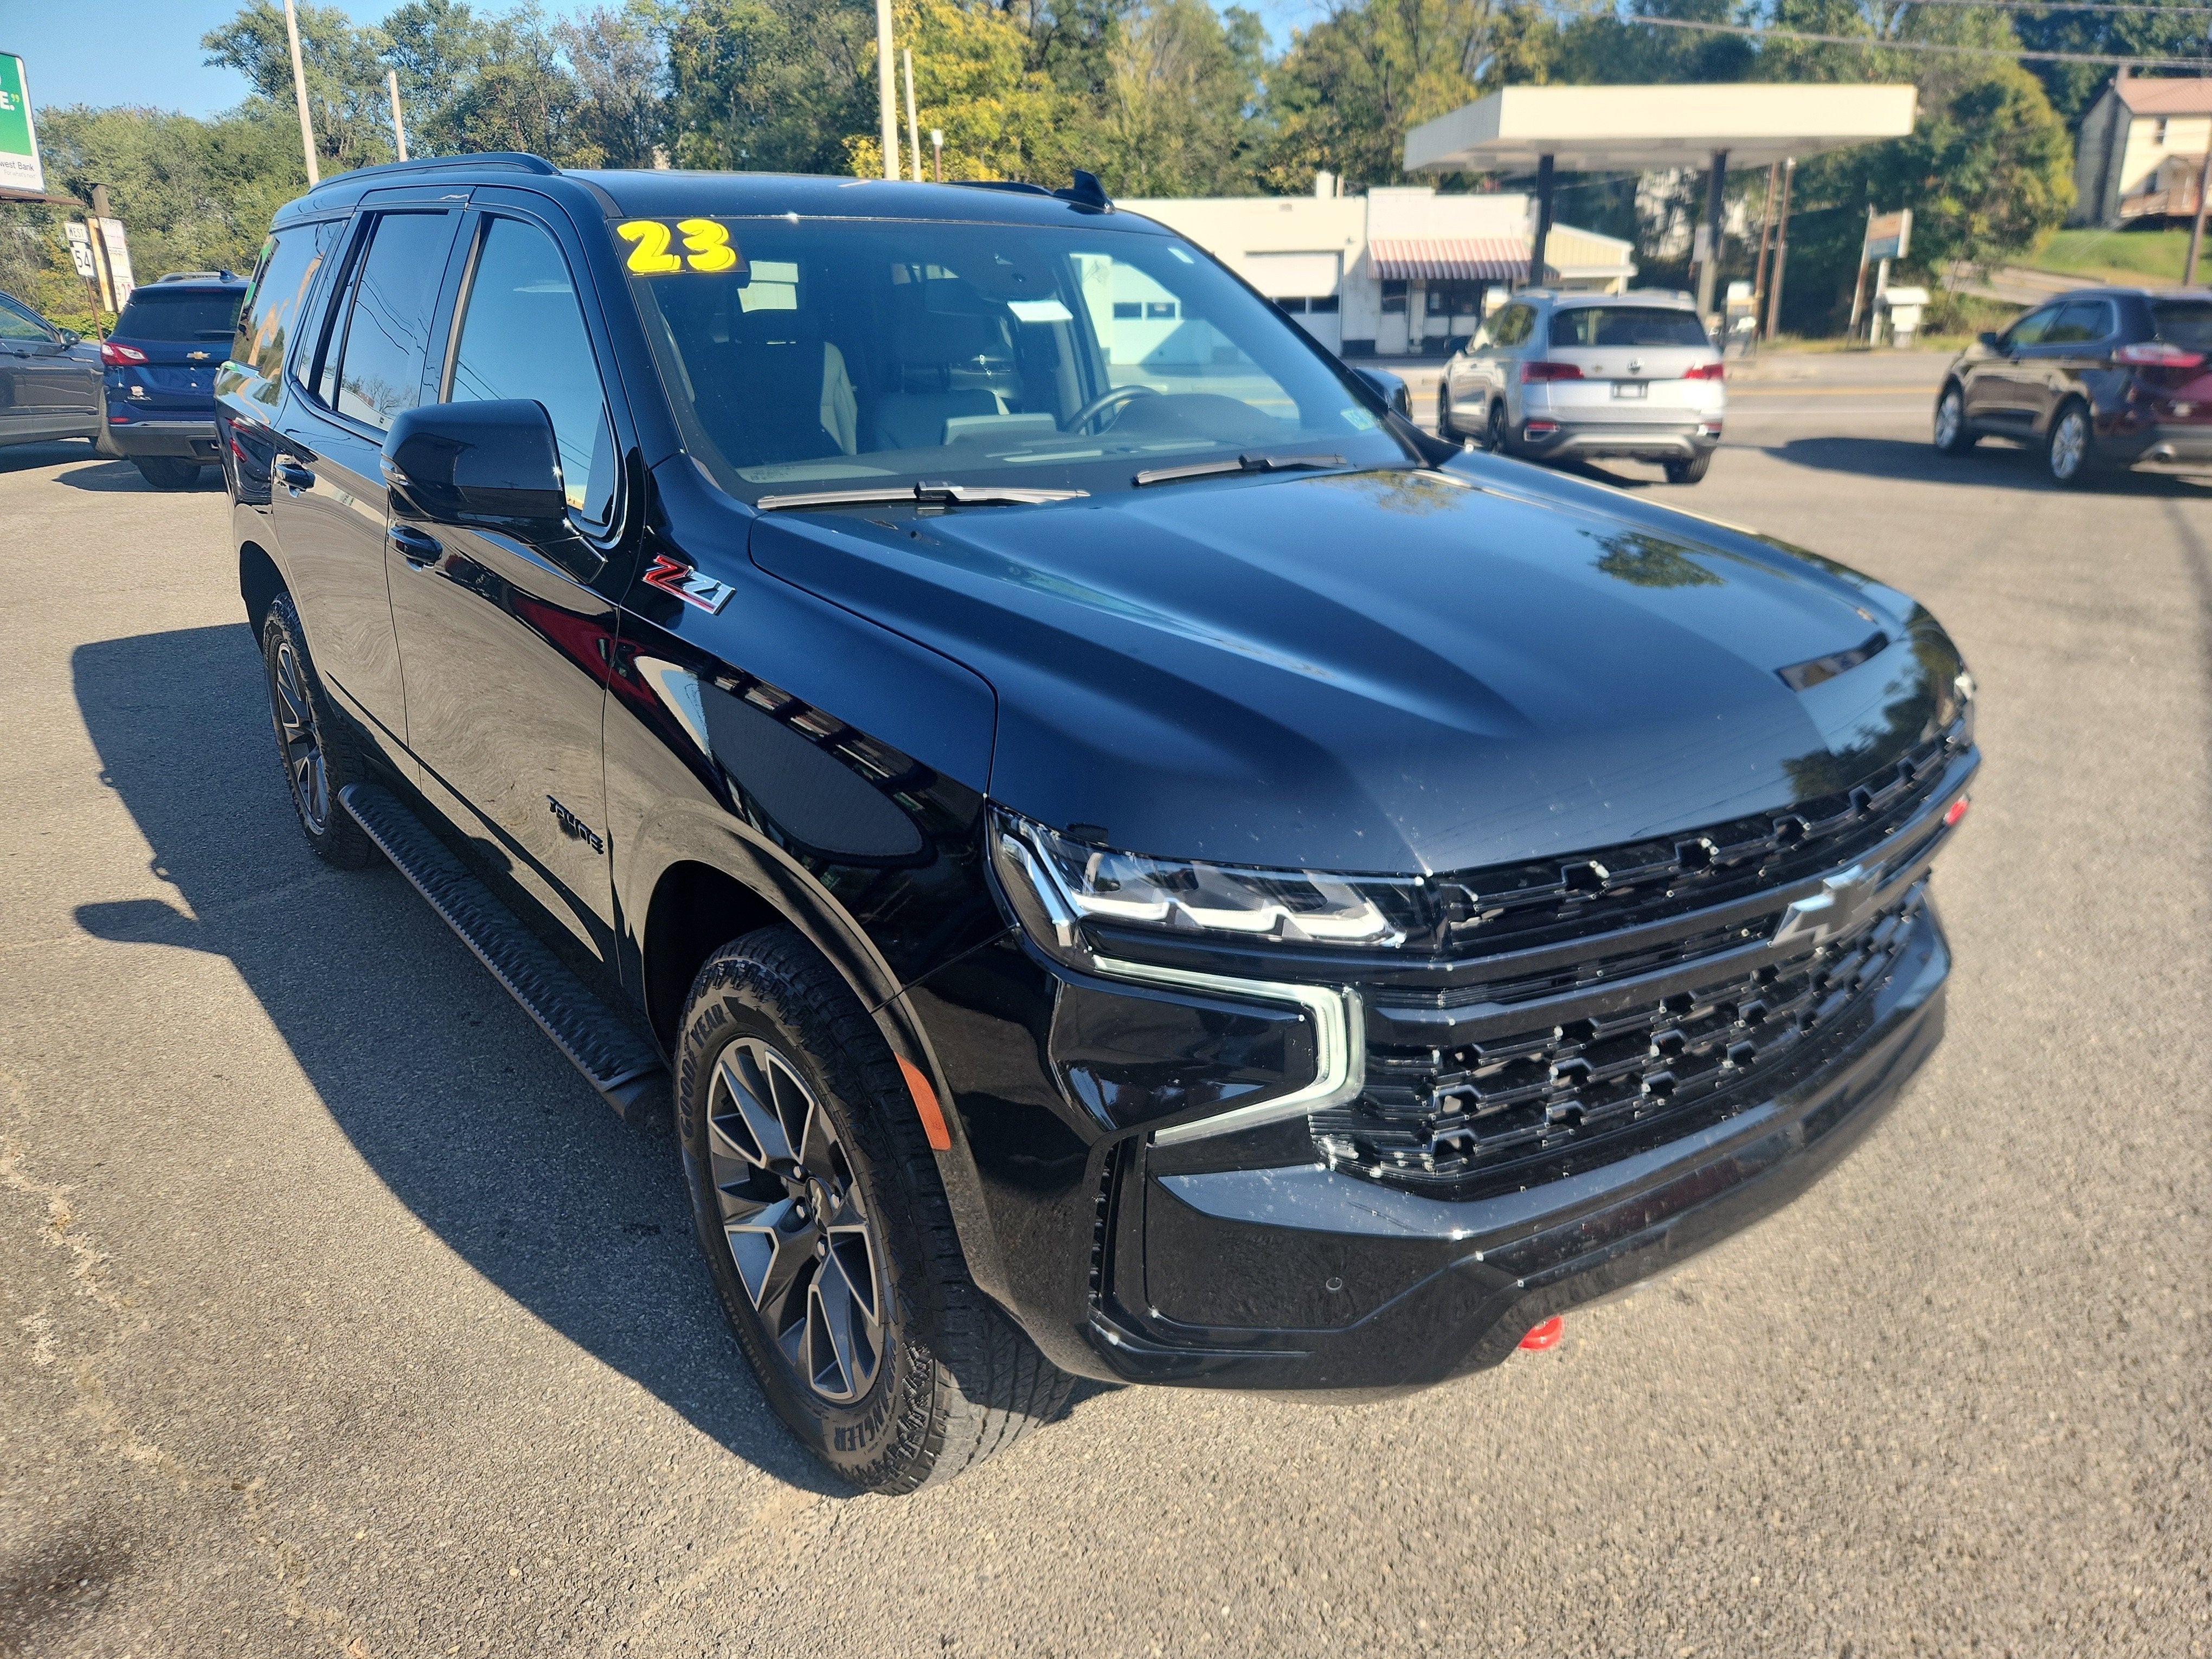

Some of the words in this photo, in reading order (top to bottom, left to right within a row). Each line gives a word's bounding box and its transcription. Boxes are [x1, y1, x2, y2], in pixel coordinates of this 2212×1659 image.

[17, 162, 34, 171] Bank
[67, 226, 84, 238] WEST
[75, 250, 91, 268] 54
[616, 219, 736, 272] 23
[641, 553, 737, 616] Z71
[546, 795, 604, 855] TAHOE
[680, 1003, 728, 1138] GOODYEAR
[833, 1328, 896, 1451] WRANGLER
